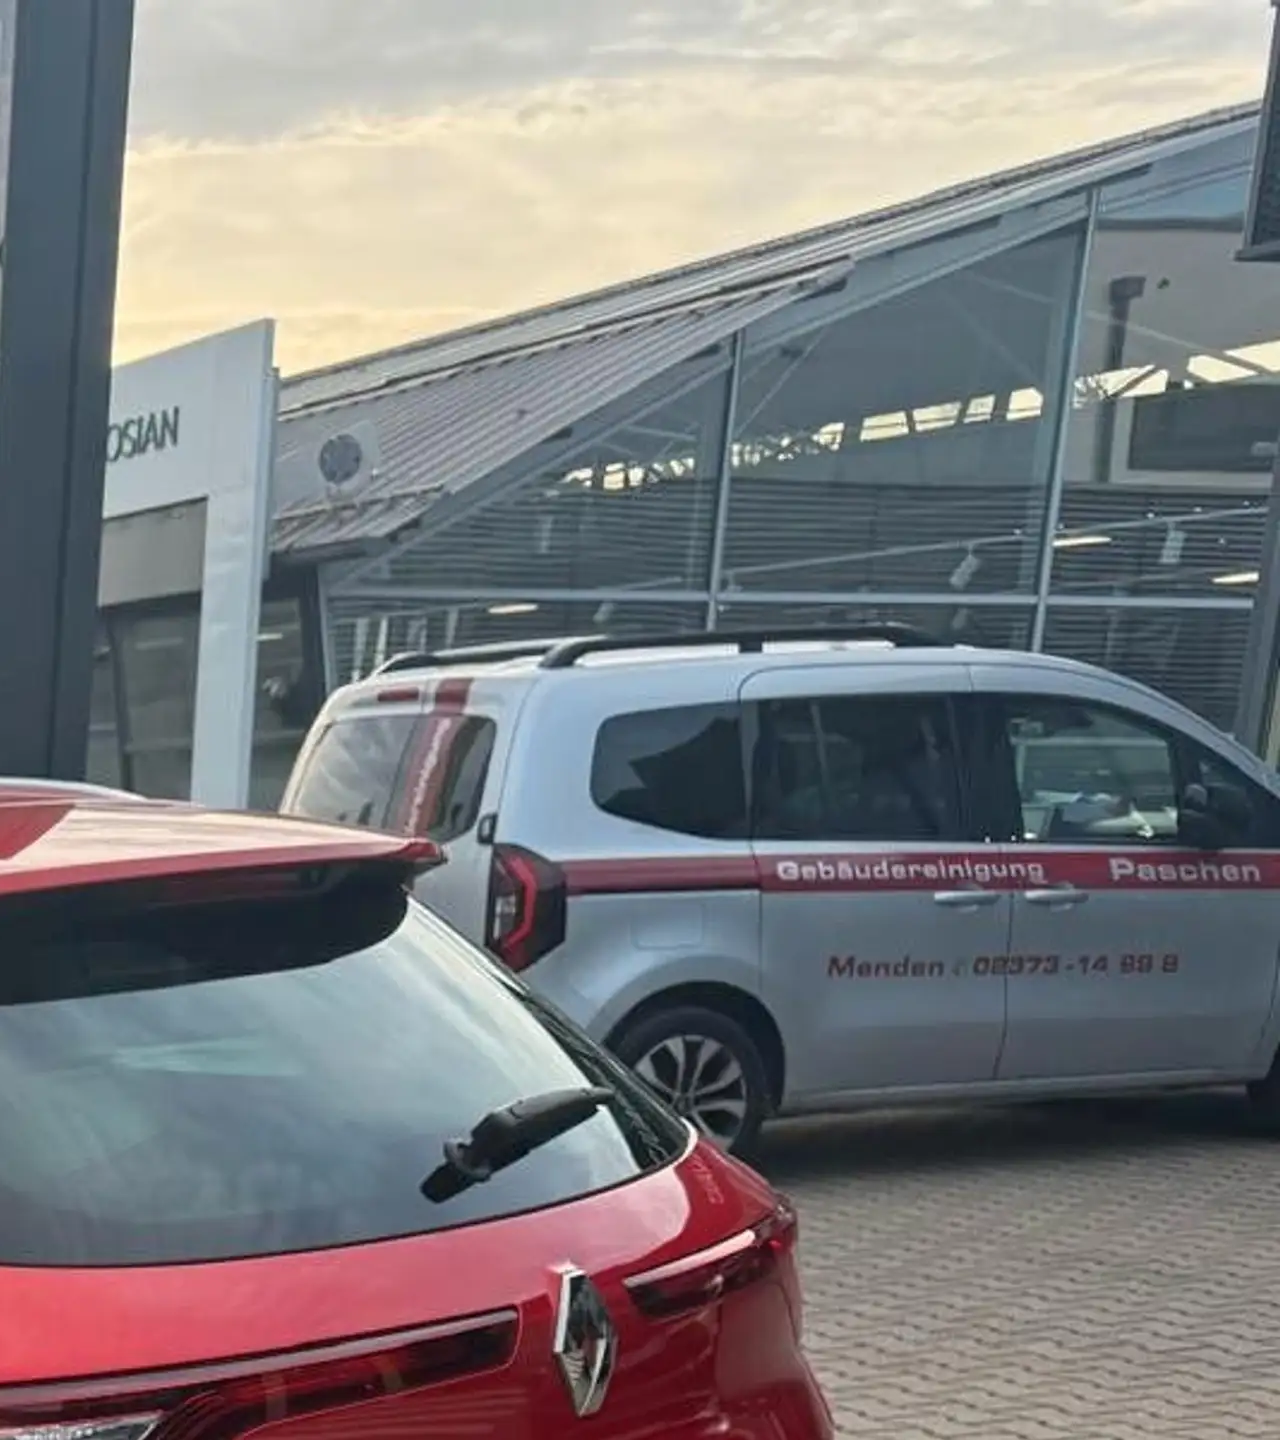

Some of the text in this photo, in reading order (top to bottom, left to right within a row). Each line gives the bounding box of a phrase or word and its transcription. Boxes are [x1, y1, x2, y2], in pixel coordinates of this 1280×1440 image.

[776, 857, 1261, 884] Gebäudereinigung Paschen
[827, 955, 944, 979] Menden
